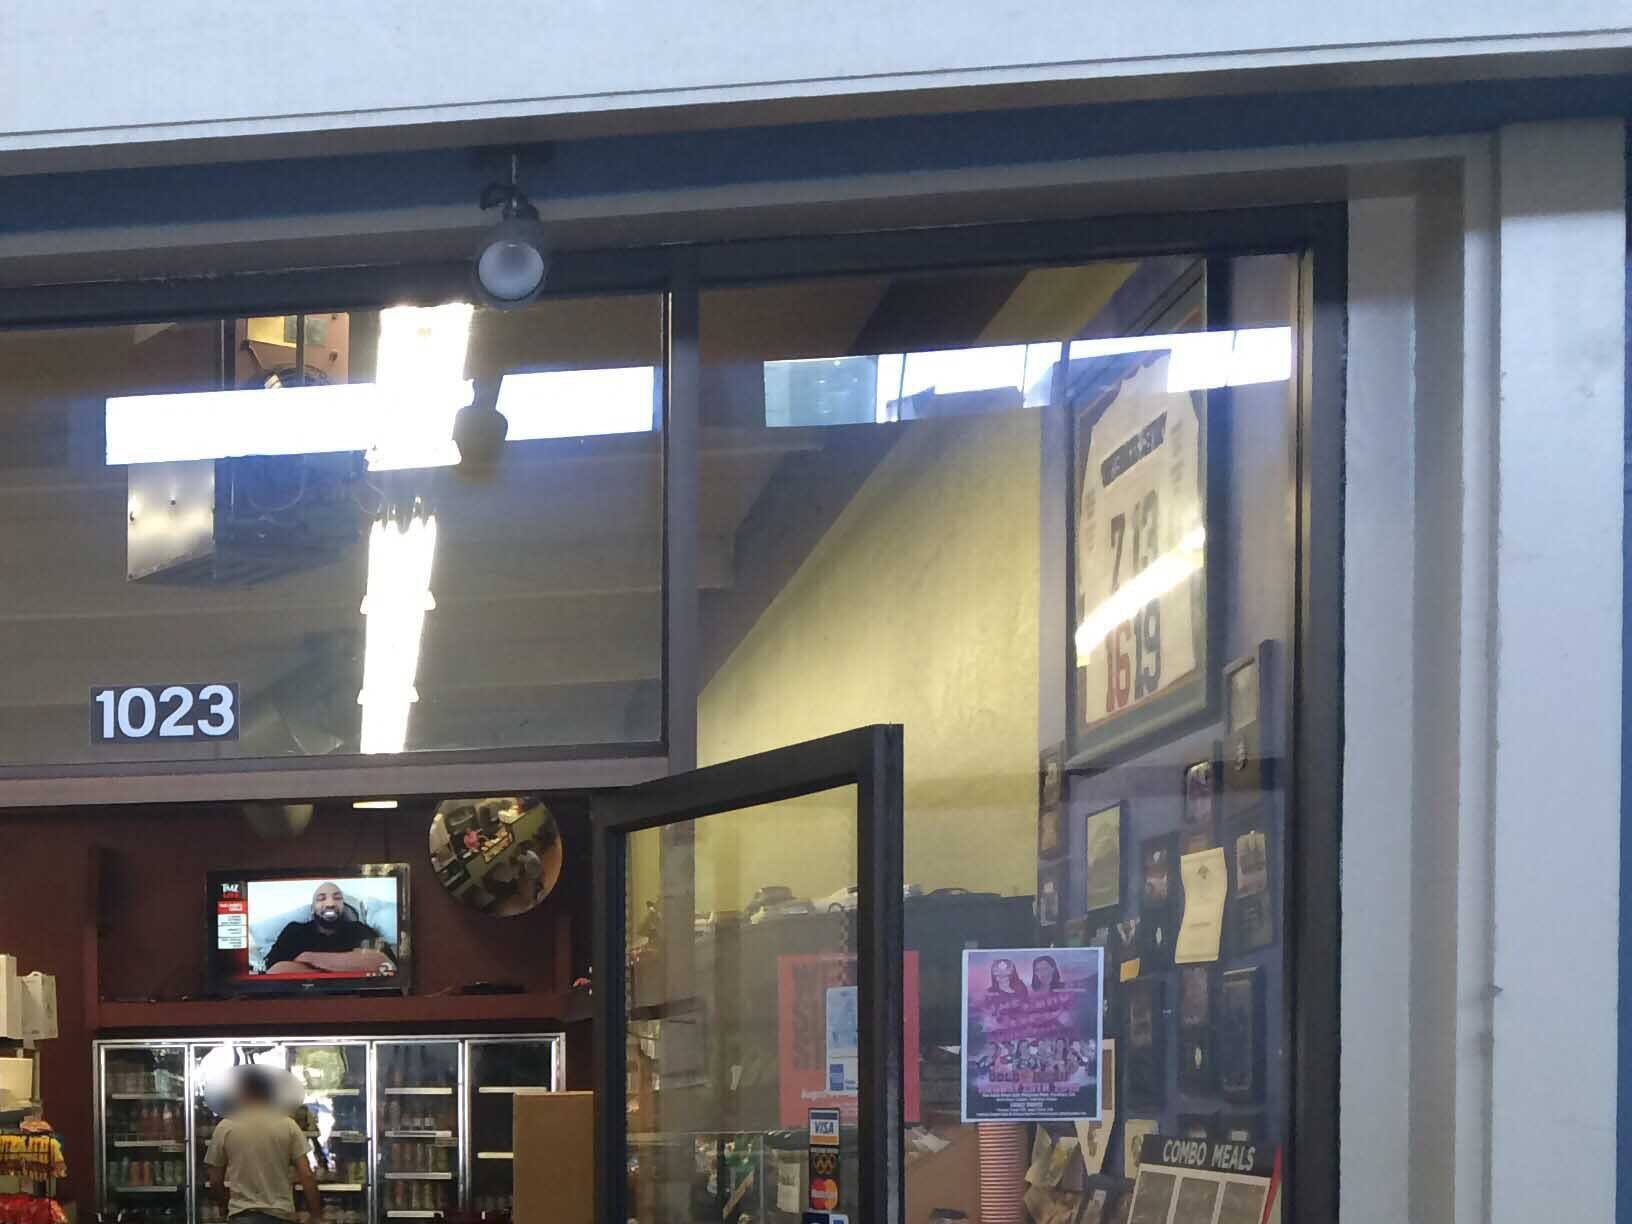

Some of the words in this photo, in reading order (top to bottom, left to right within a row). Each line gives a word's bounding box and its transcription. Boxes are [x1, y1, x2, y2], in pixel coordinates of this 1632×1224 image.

[96, 684, 234, 738] 1023
[814, 1121, 835, 1135] VISA
[1163, 1139, 1207, 1166] COMBO
[1211, 1144, 1255, 1171] MEALS
